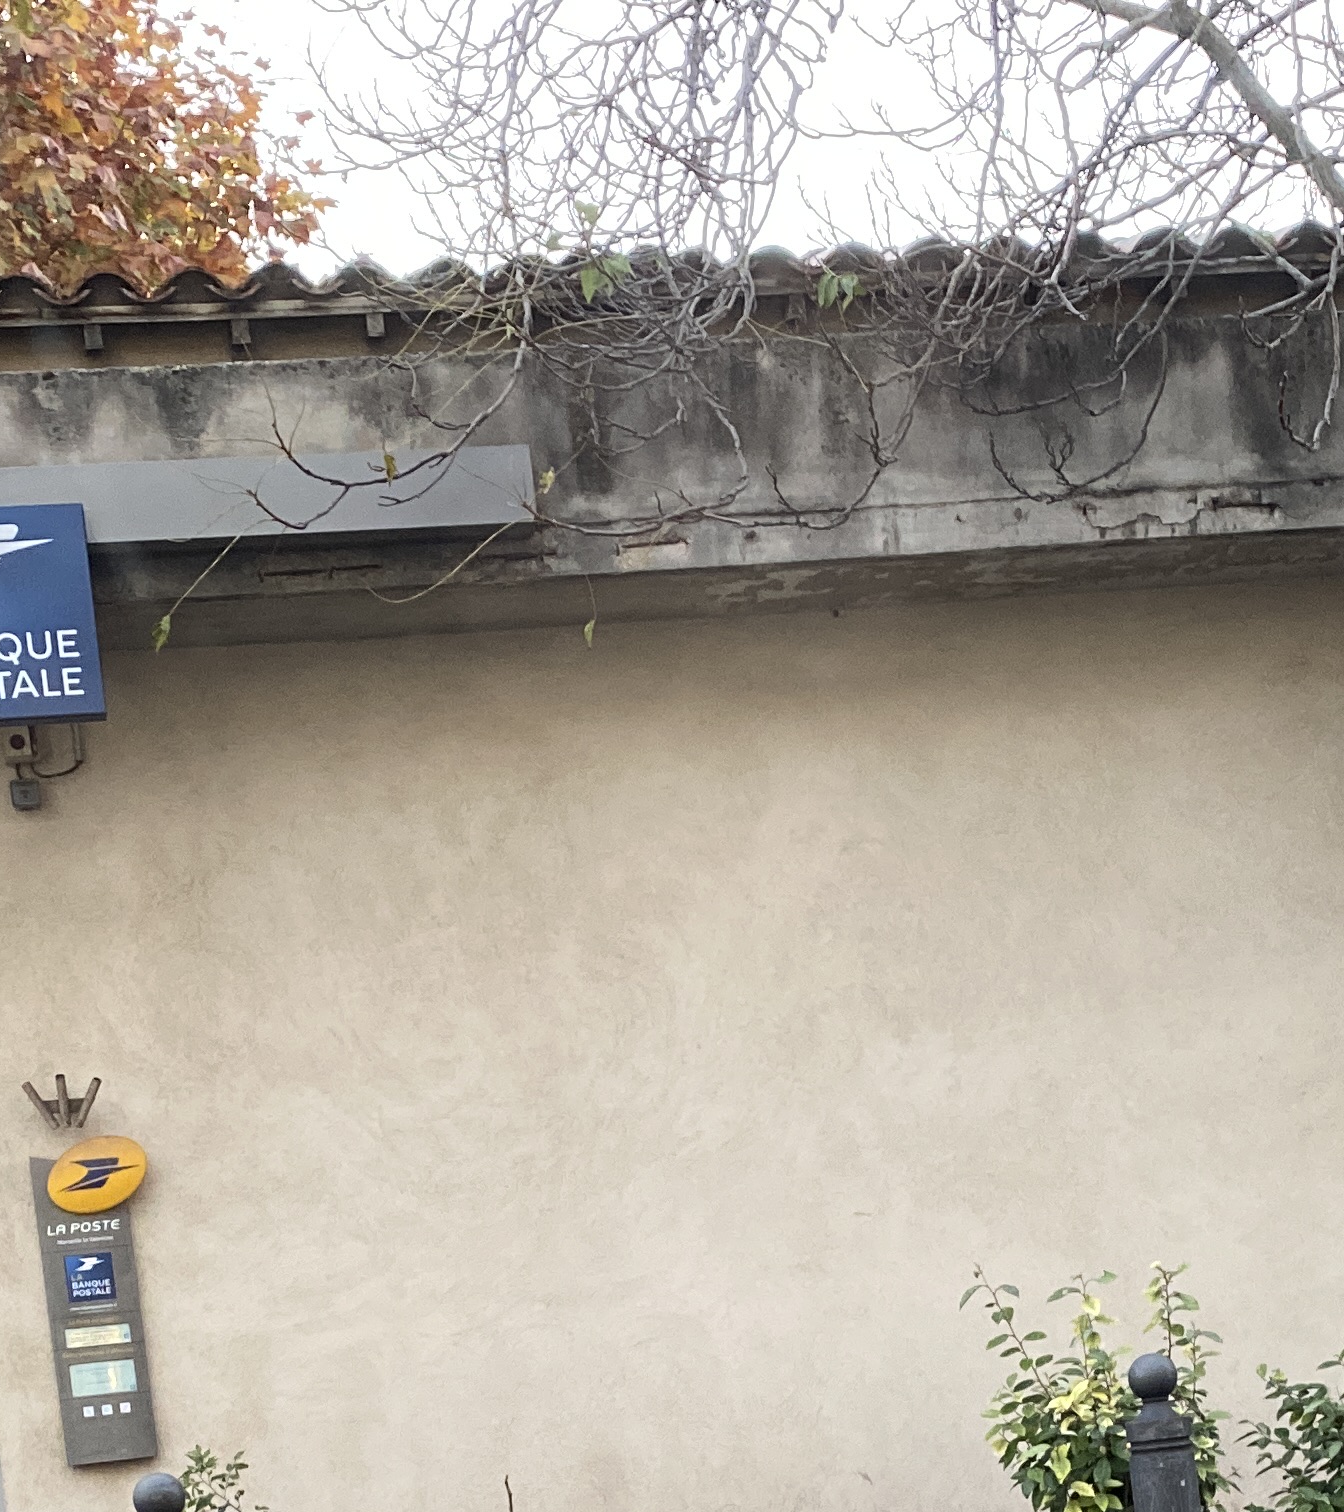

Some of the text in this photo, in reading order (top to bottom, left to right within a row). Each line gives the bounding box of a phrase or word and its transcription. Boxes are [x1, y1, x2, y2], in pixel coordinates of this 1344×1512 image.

[47, 1219, 120, 1236] LA POSTE
[70, 1273, 83, 1281] LA
[72, 1278, 110, 1290] BANQUE
[73, 1286, 111, 1298] POSTALE
